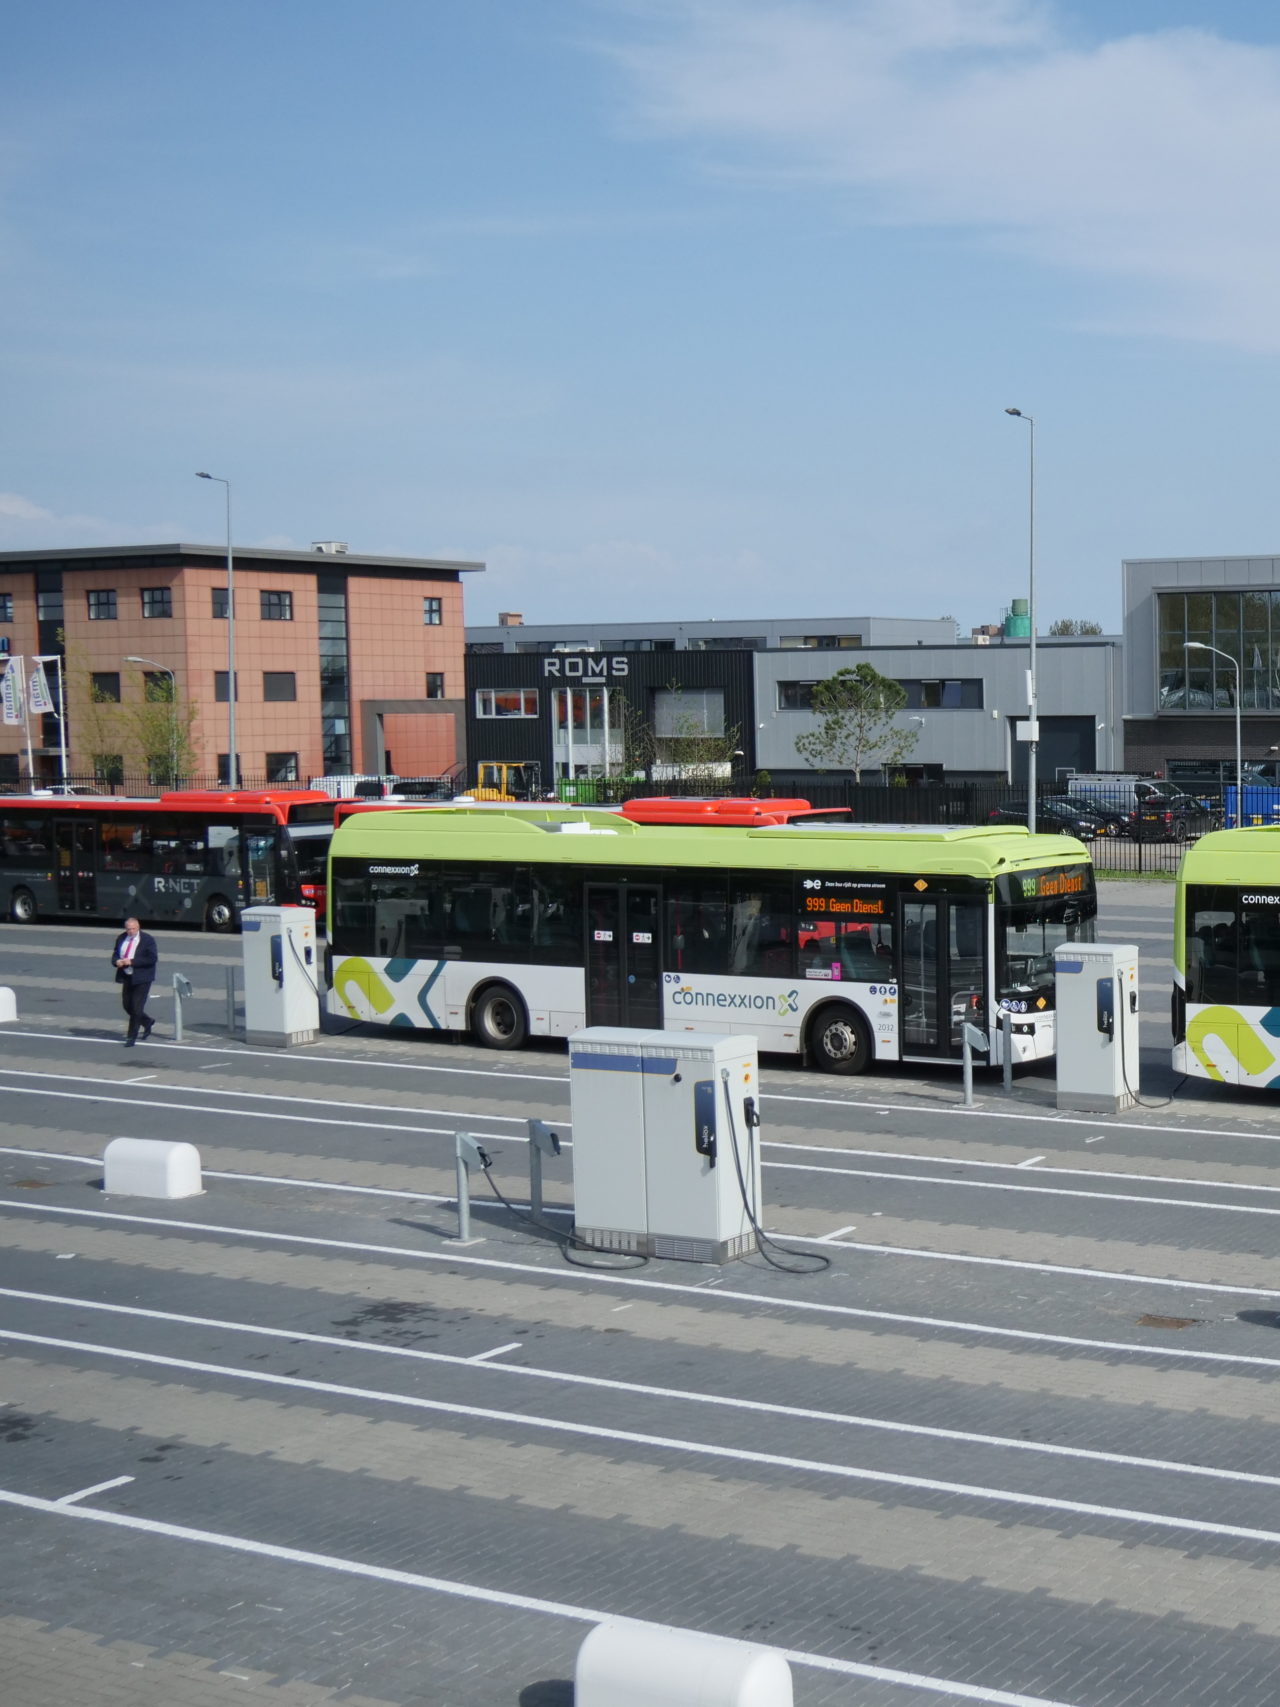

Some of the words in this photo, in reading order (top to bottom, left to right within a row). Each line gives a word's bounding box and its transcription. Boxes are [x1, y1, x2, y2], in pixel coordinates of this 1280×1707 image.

[544, 657, 629, 677] ROMS
[369, 865, 411, 874] connexxion
[1023, 878, 1036, 897] 999
[1040, 875, 1058, 896] Geen
[1059, 873, 1083, 894] Dienst
[806, 897, 826, 911] 999
[829, 898, 851, 912] Geen
[853, 898, 884, 914] Dienst
[672, 990, 776, 1010] connexxion
[878, 1023, 894, 1032] 2032
